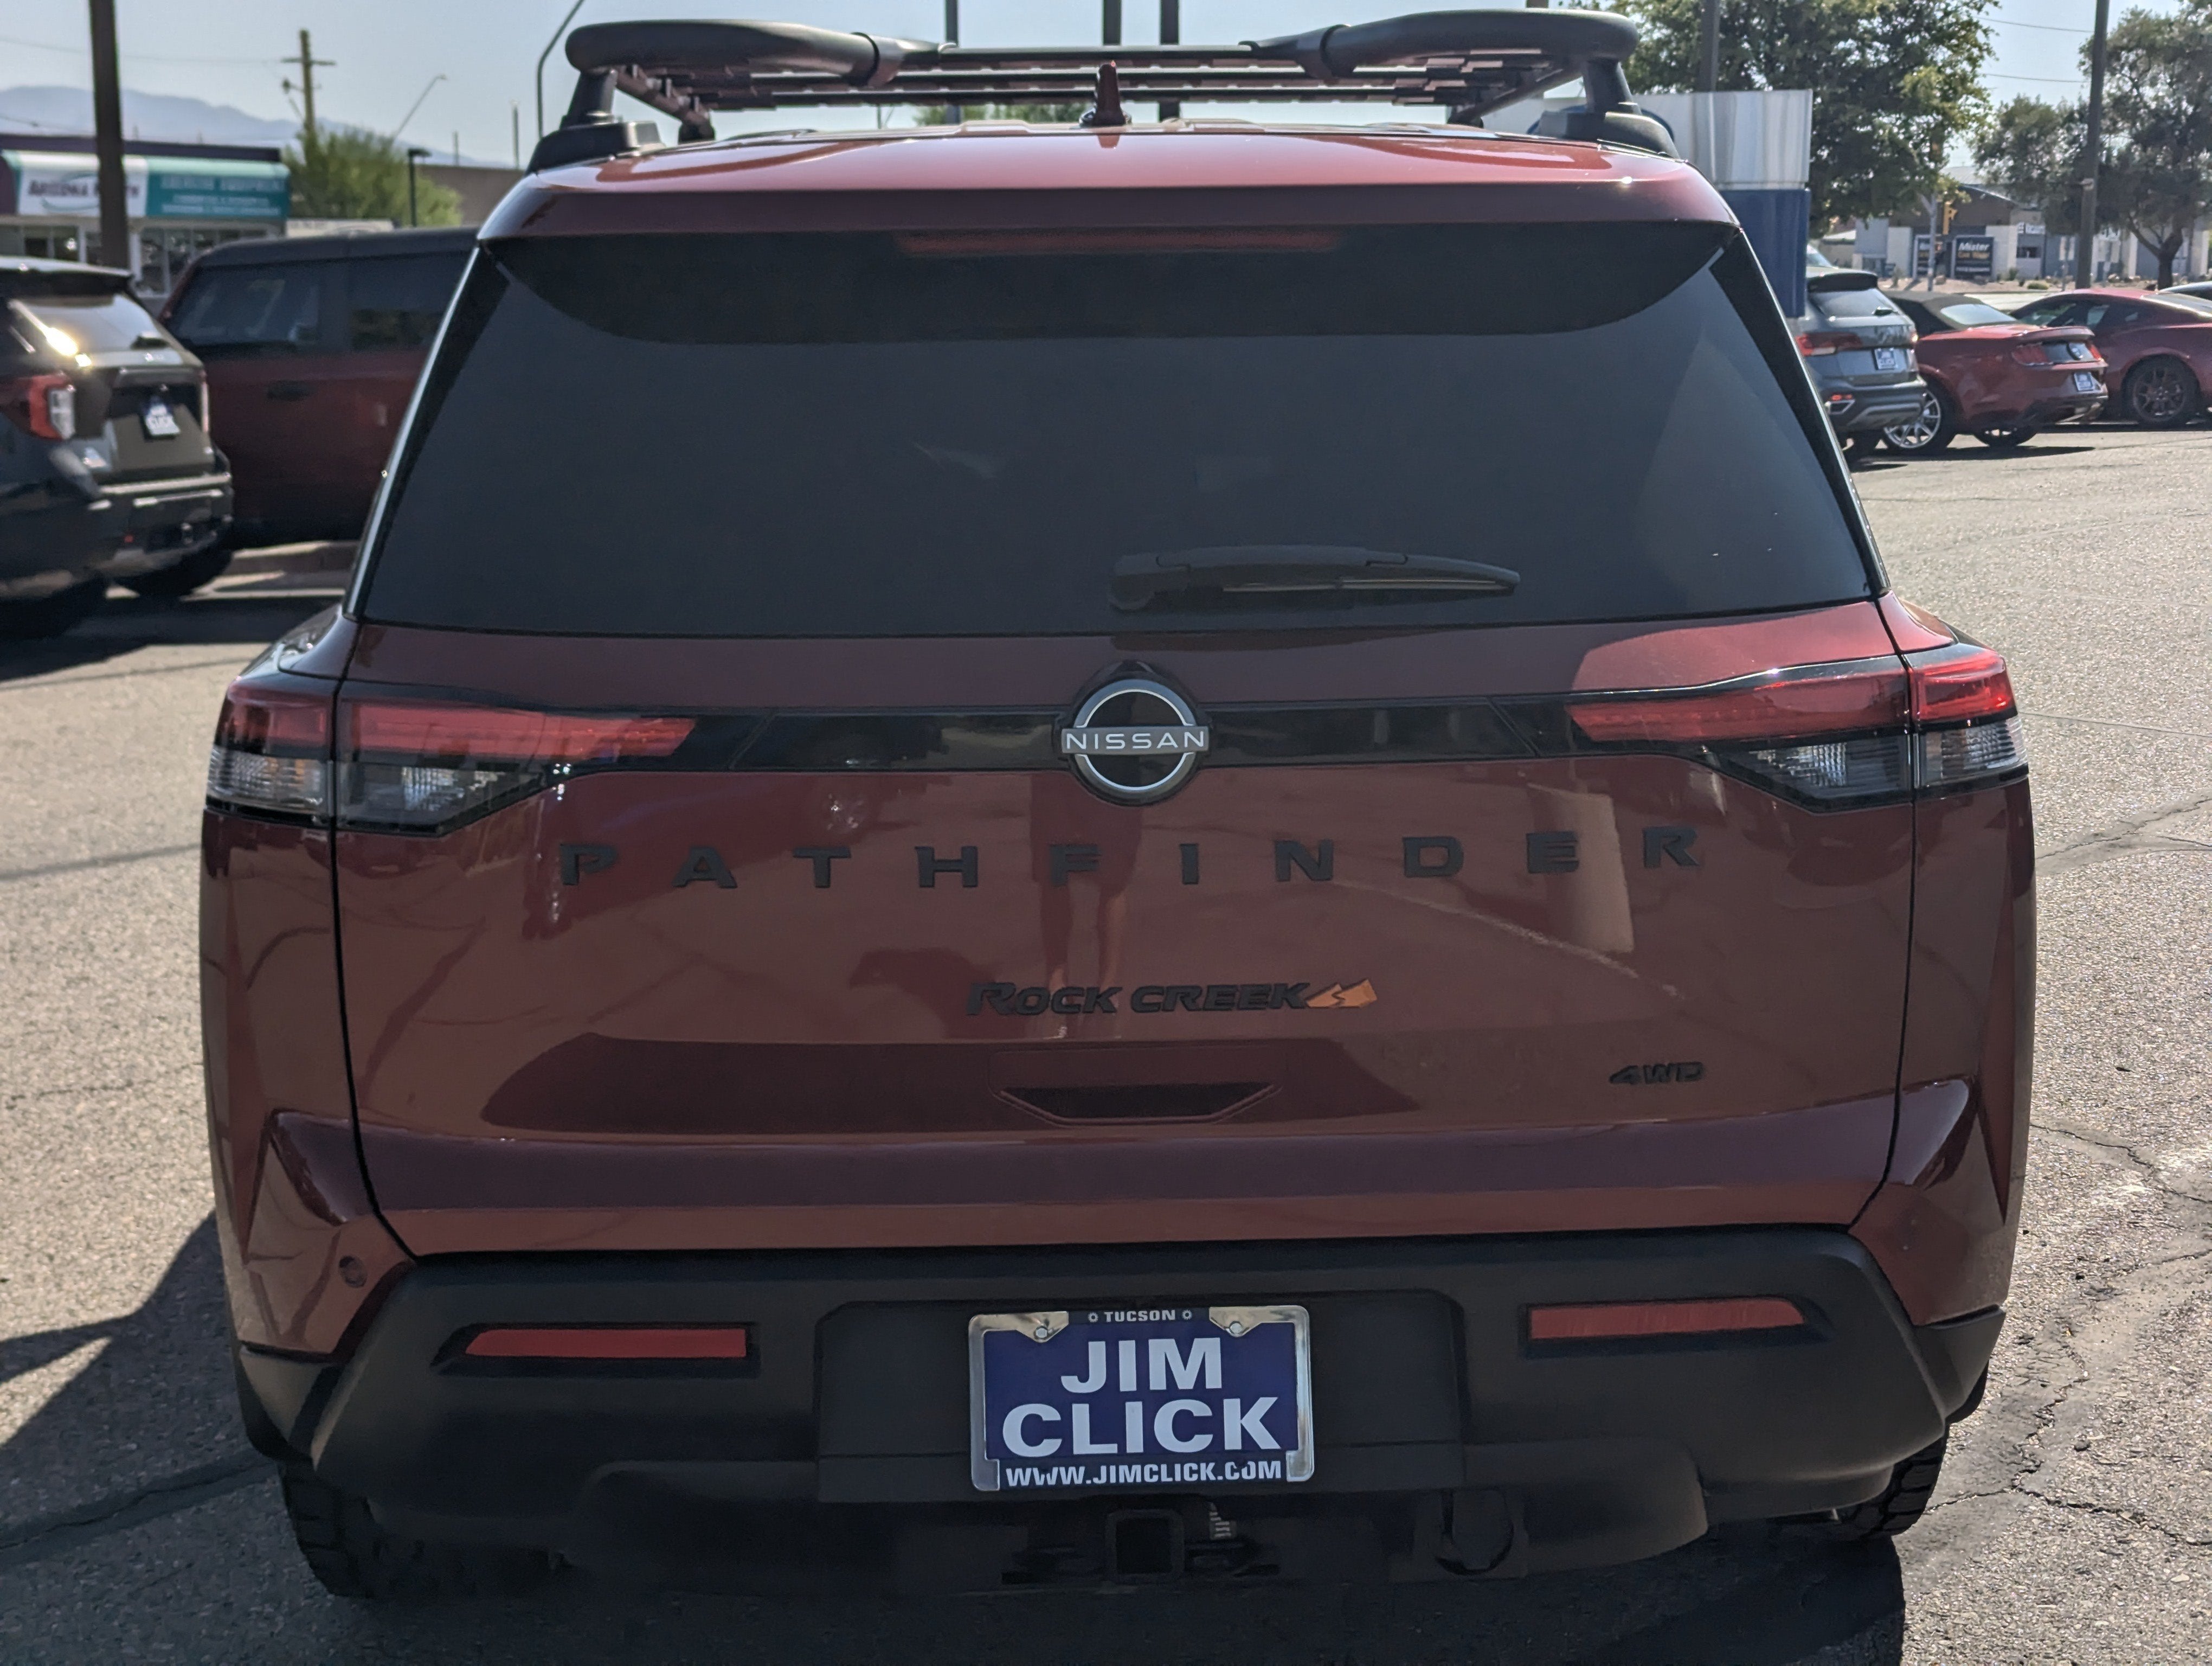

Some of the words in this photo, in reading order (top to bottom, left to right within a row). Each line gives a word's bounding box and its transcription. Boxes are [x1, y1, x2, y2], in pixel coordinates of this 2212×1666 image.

[1958, 242, 1991, 252] Mister
[1066, 731, 1205, 749] NISSAN
[559, 825, 1702, 888] PATHFINDER
[966, 981, 1123, 1016] ROCK
[1131, 982, 1310, 1014] CREEK
[1609, 1061, 1705, 1085] 4WD
[1104, 1310, 1175, 1323] TUCSON
[1060, 1337, 1223, 1394] JIM
[1002, 1396, 1281, 1458] CLICK
[1006, 1460, 1282, 1487] WWW.JIMCLICK.COM
